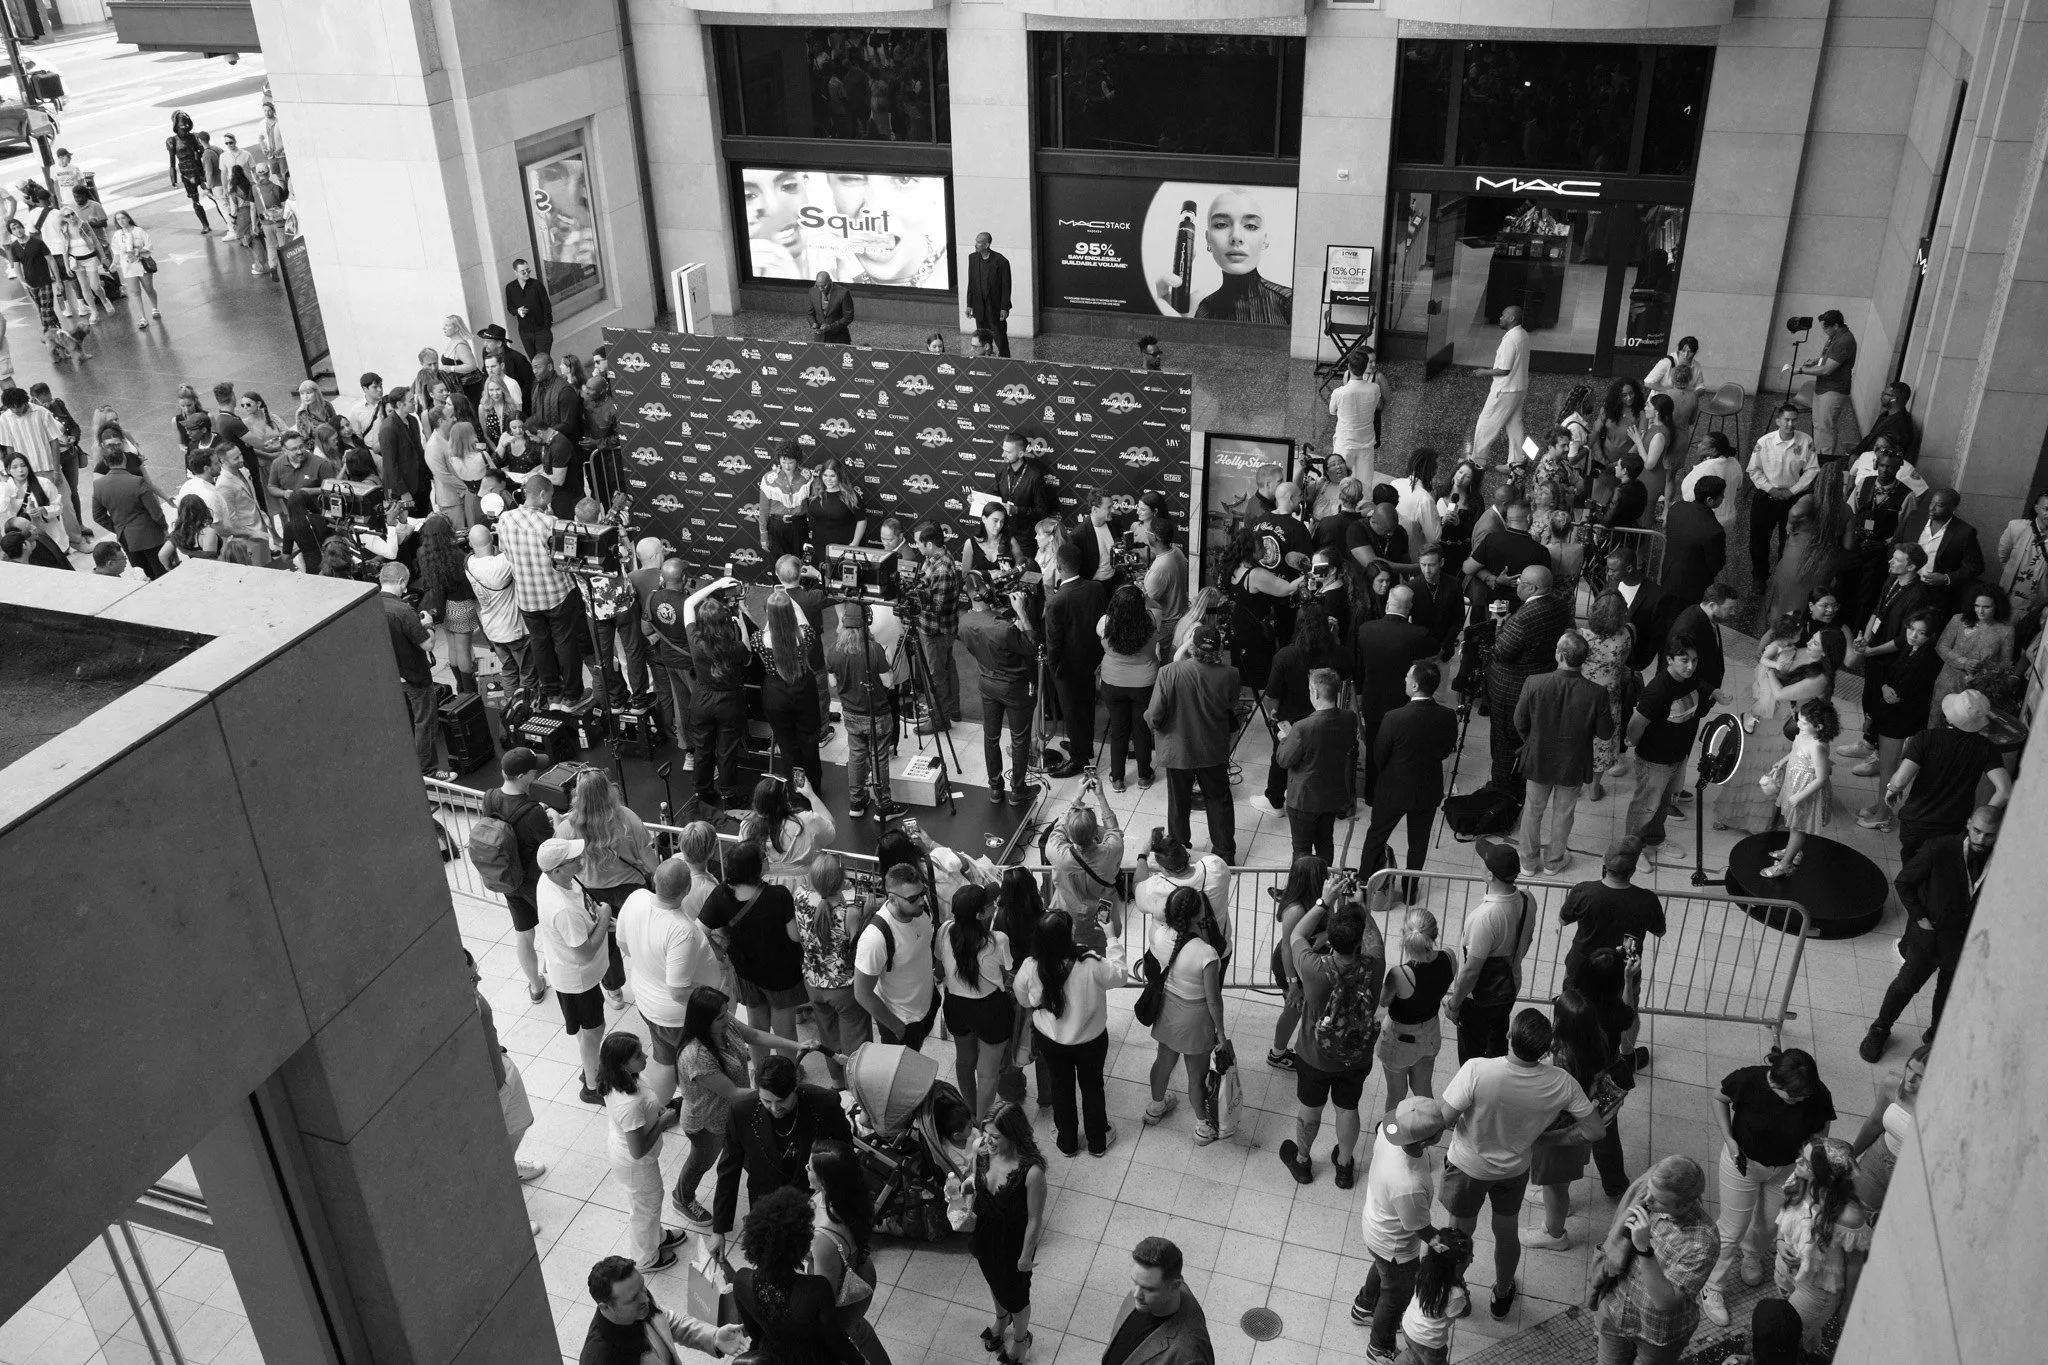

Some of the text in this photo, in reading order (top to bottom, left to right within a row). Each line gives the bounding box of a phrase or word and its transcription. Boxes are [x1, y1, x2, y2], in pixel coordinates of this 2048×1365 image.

[800, 206, 890, 239] Squirt
[1106, 221, 1131, 230] STACK
[1074, 241, 1115, 256] 95%
[1331, 267, 1367, 276] 15% OFF
[1622, 337, 1643, 347] 107
[800, 371, 836, 382] HollyShorts
[896, 380, 935, 390] HollyShorts
[996, 389, 1036, 400] HollyShorts
[1101, 398, 1143, 409] HollyShorts
[794, 405, 813, 414] Kodak
[820, 424, 856, 433] HollyShorts
[875, 429, 894, 438] Kodak
[916, 433, 953, 443] HollyShorts
[1090, 431, 1115, 441] OVATION
[1119, 452, 1160, 462] HollyShorts
[1057, 463, 1081, 472] Kodak
[902, 479, 940, 489] HollyShorts
